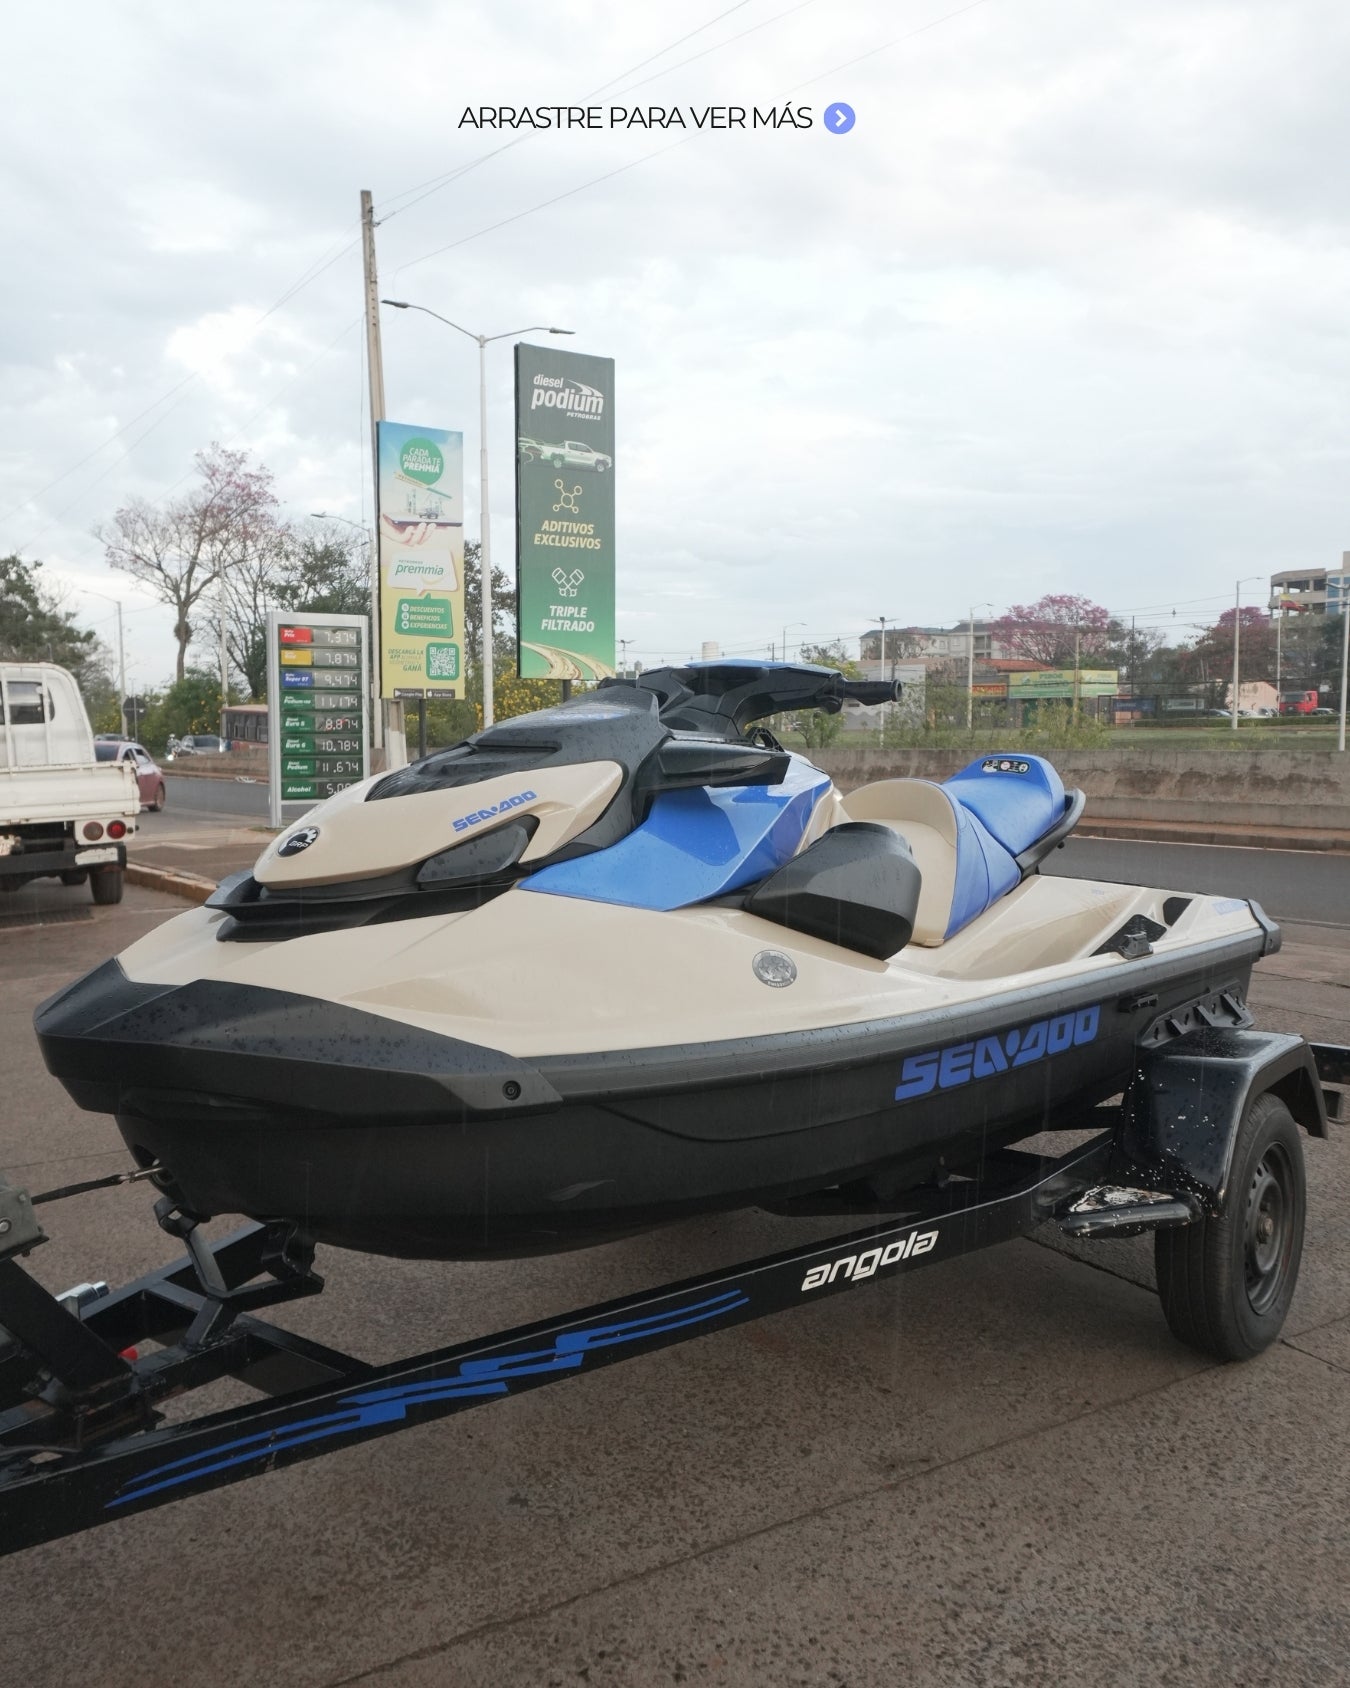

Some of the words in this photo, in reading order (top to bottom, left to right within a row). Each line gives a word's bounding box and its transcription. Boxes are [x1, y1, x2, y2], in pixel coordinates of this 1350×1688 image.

[533, 374, 564, 388] diesel
[531, 388, 604, 414] podium
[566, 411, 602, 421] PETROBRAS
[409, 447, 429, 457] CADA
[403, 454, 431, 464] PARADA
[403, 461, 441, 473] PREMMIA
[541, 520, 595, 535] ADITIVOS
[534, 534, 601, 550] EXCLUSIVOS
[395, 564, 444, 576] premmia
[550, 605, 587, 618] TRIPLE
[541, 619, 595, 633] FILTRADO
[325, 630, 356, 643] 7.374
[325, 652, 357, 665] 7.874
[325, 674, 357, 686] 9.474
[321, 696, 357, 708] 11.174
[325, 718, 358, 730] 8.874
[322, 740, 359, 752] 10.784
[801, 1230, 939, 1292] angola
